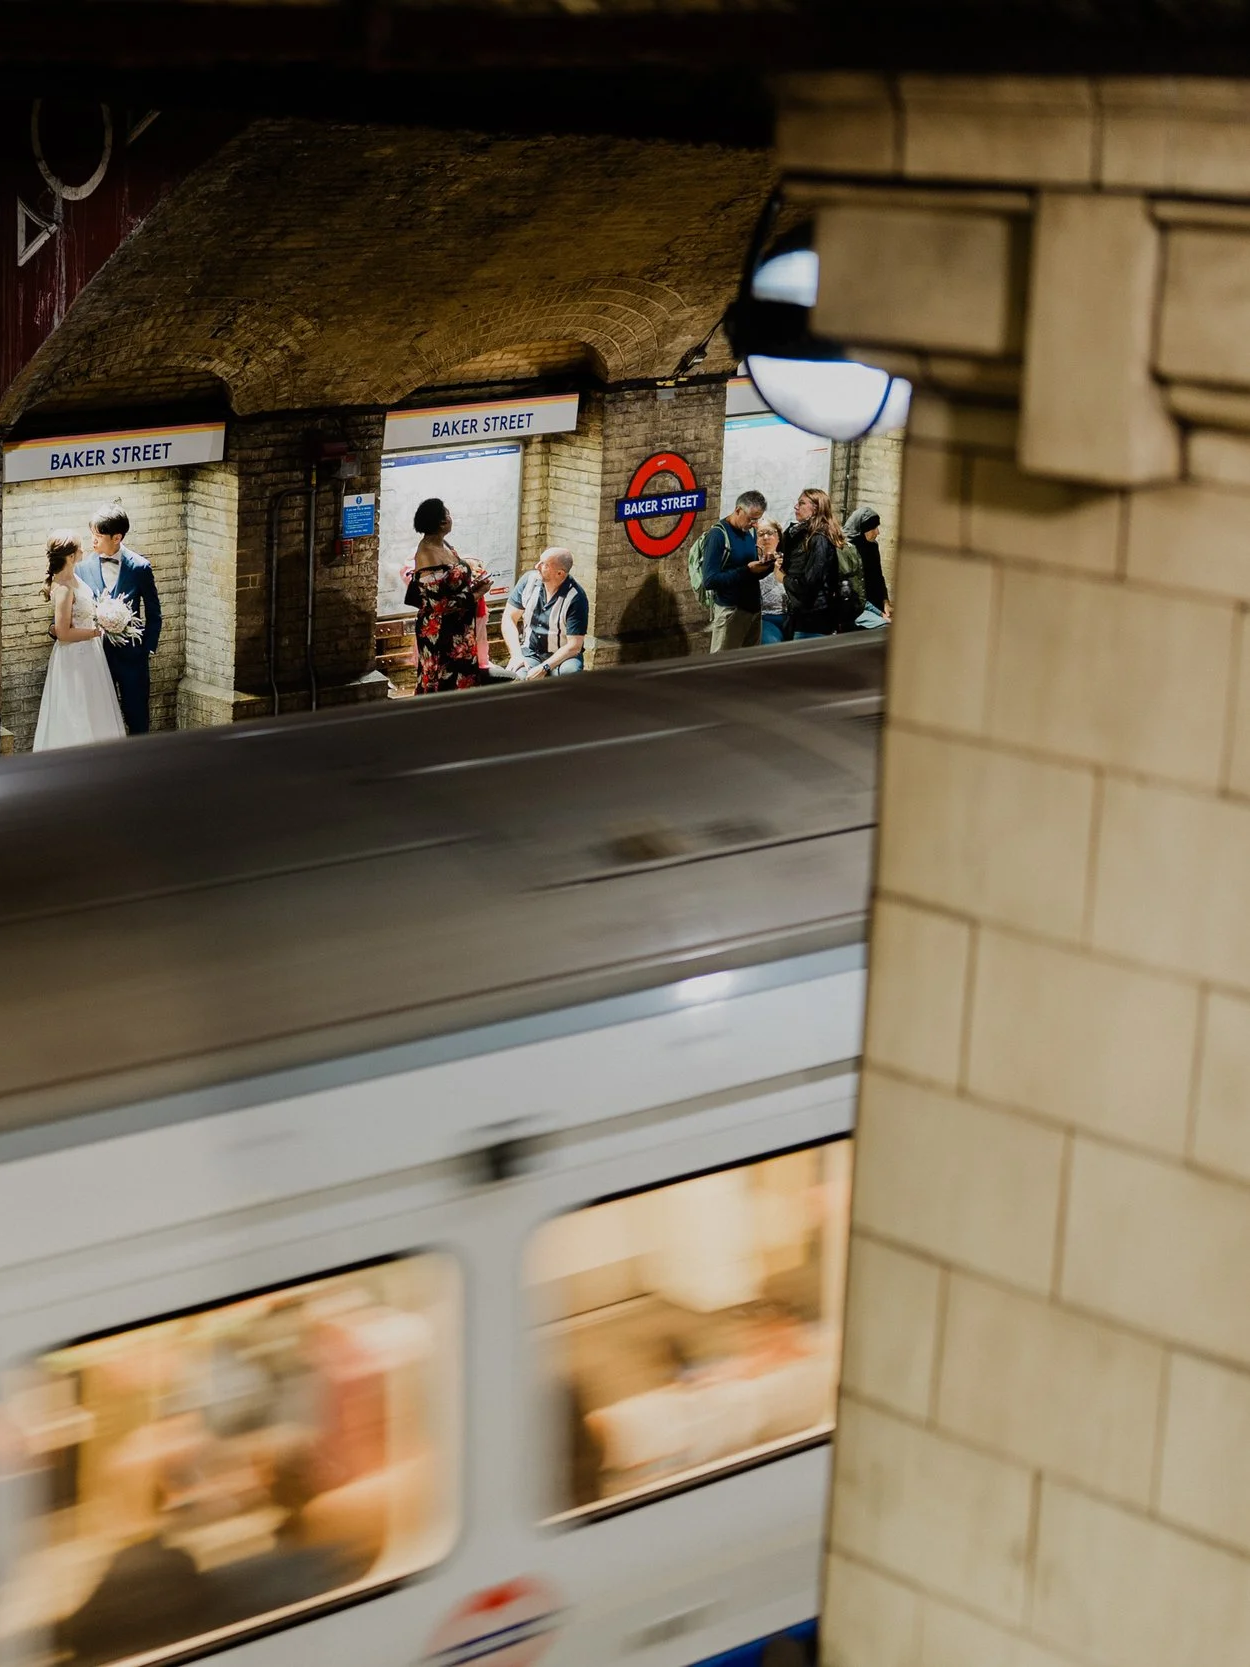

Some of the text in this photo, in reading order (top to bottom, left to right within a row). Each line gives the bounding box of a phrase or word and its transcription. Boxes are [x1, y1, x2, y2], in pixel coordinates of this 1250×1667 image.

[432, 413, 534, 438] BAKER STREET
[50, 442, 172, 471] BAKER STREET
[624, 494, 699, 515] BAKER STREET
